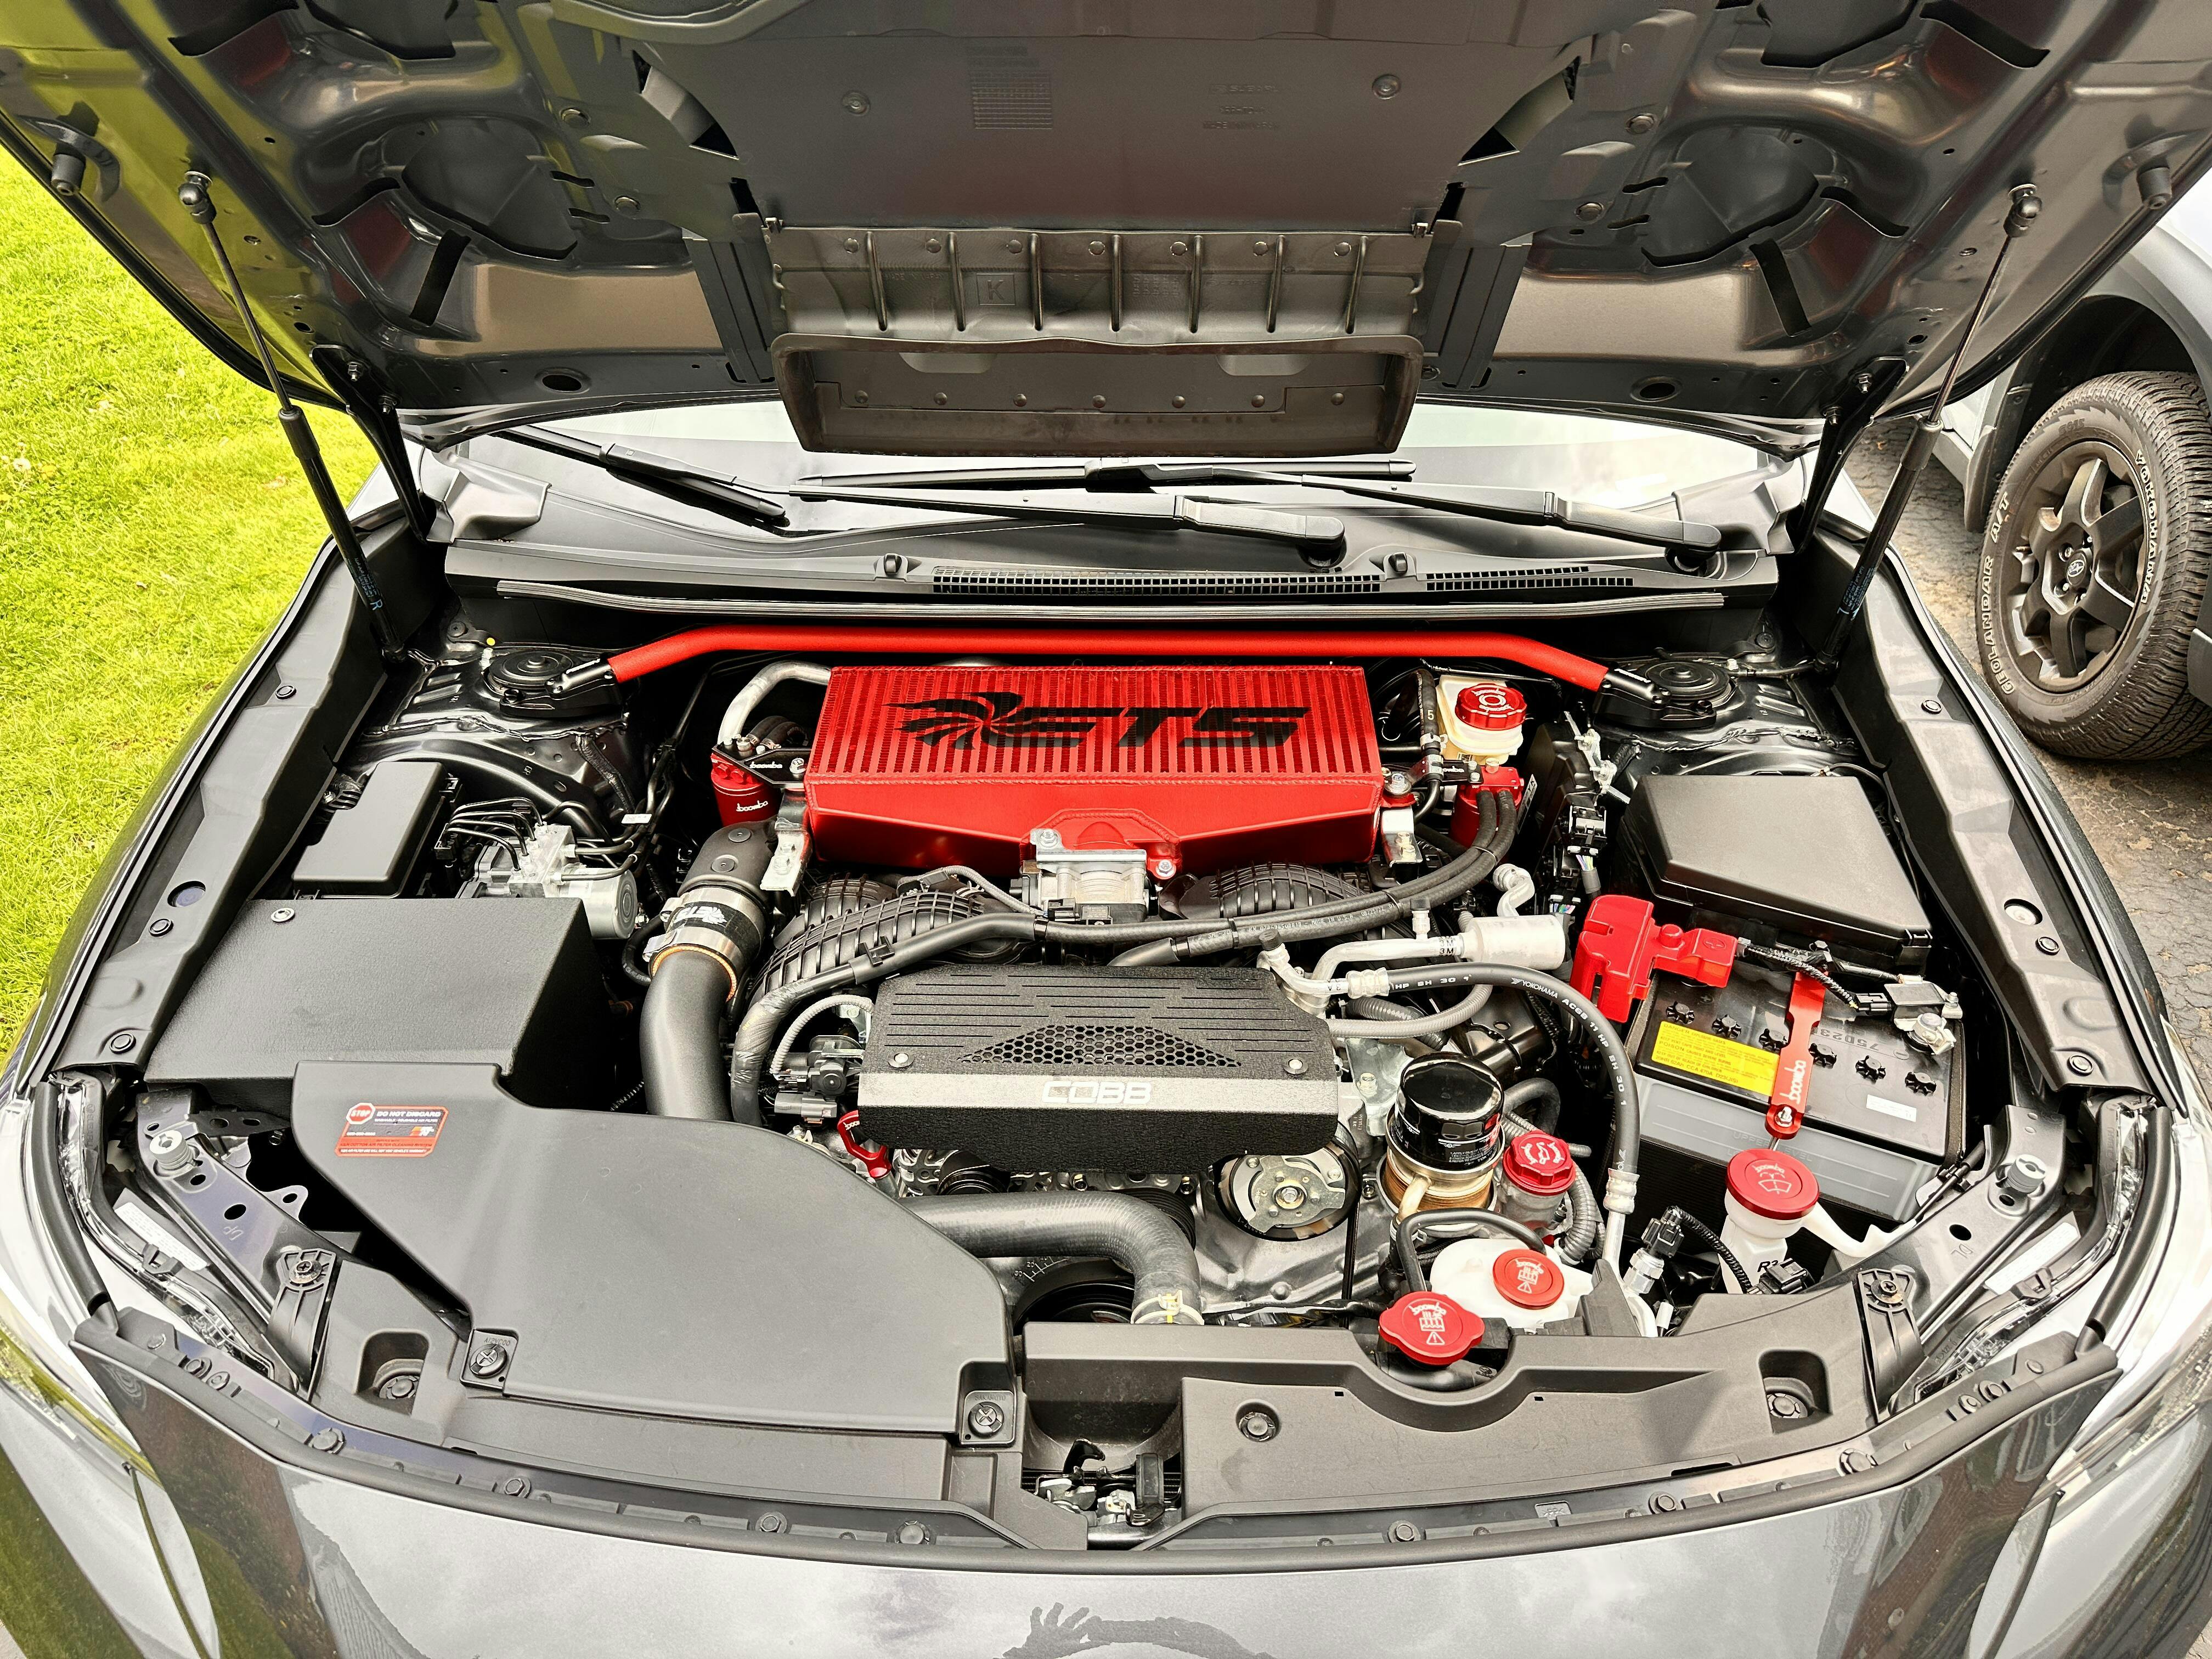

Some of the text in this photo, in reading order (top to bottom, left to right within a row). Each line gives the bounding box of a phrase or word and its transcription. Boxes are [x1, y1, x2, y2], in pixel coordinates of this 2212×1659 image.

[988, 280, 1005, 300] K
[2135, 449, 2159, 604] YOKOHAMA
[1980, 492, 2016, 695] GEOLANDAR A/T
[370, 599, 383, 611] R
[1427, 709, 1434, 720] 5
[736, 800, 769, 812] boomba
[1522, 979, 1559, 998] YOKOHAMA
[1598, 1033, 1610, 1048] HP
[1663, 1024, 1690, 1034] DANGER
[1659, 1041, 1685, 1052] POISON
[1655, 1055, 1670, 1063] 20HR
[1779, 1059, 1807, 1105] boomba
[1042, 1081, 1152, 1104] COBB
[351, 1109, 371, 1118] STOP
[1784, 1146, 1813, 1162] EVEL
[1751, 1163, 1785, 1173] boomba
[1515, 1259, 1544, 1274] boomba
[1408, 1301, 1447, 1316] boomba
